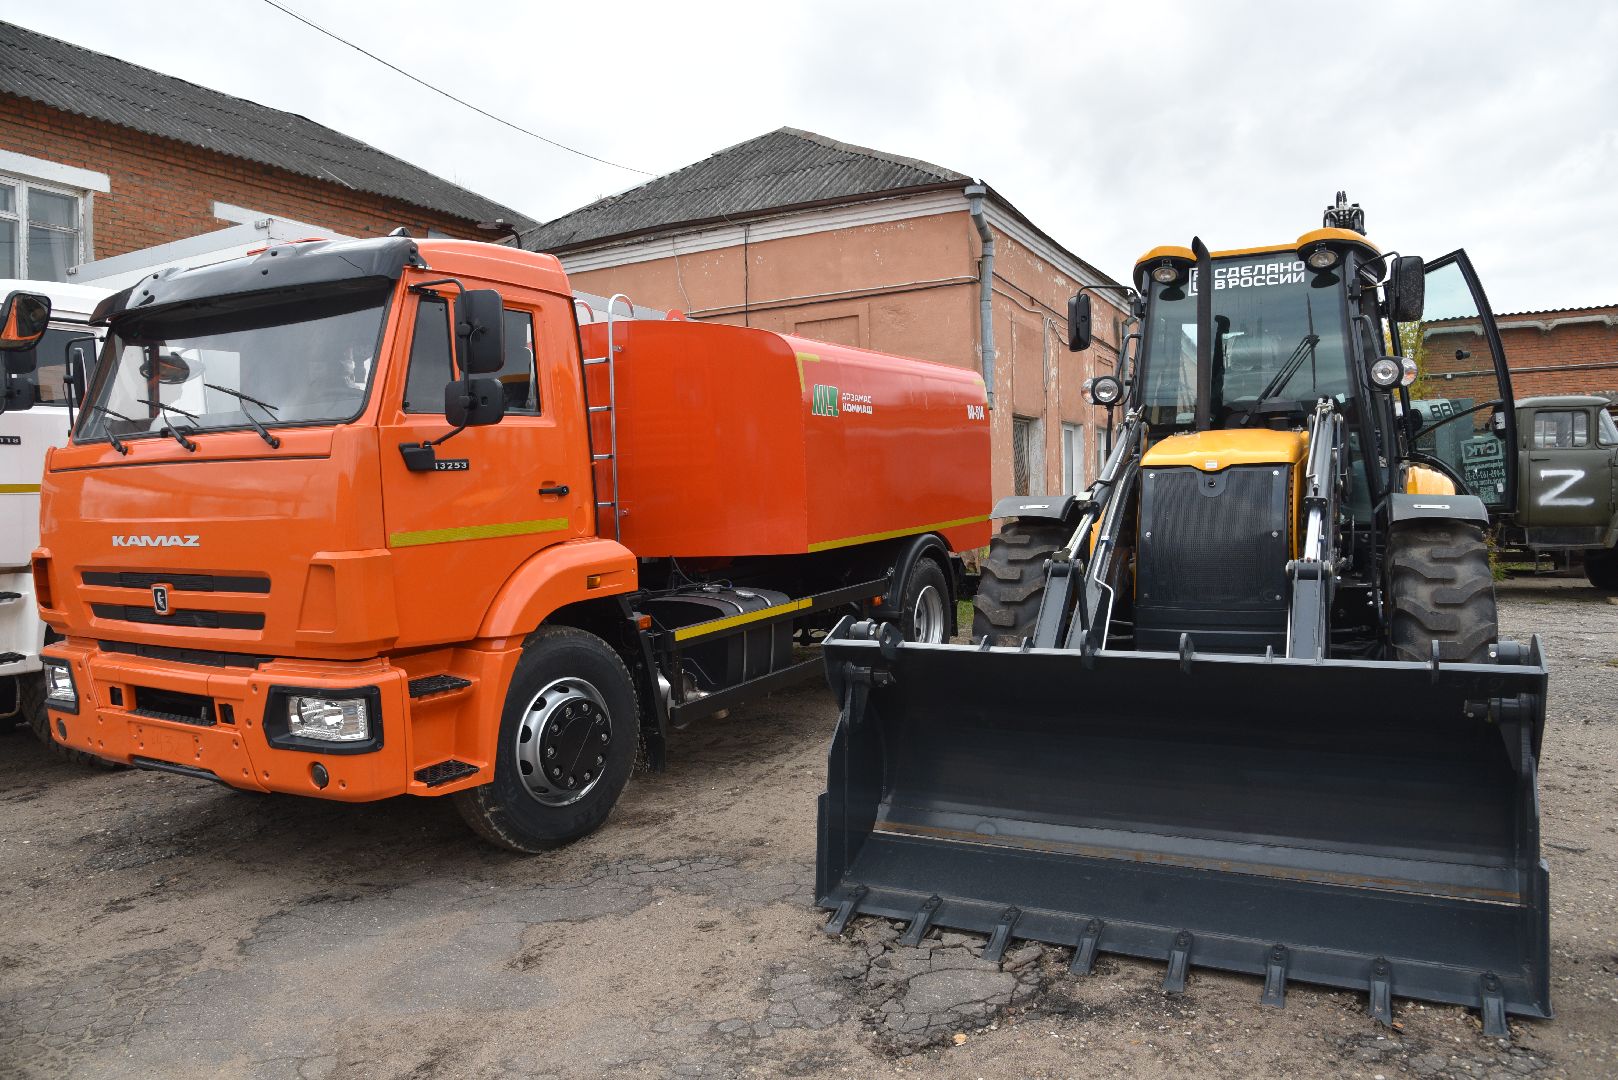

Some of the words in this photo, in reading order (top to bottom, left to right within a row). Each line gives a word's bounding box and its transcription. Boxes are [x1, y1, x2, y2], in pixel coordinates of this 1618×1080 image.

[1214, 261, 1306, 279] СДЕЛАНО
[1214, 279, 1226, 290] В
[1228, 271, 1305, 289] РОССИИ
[842, 392, 872, 404] АРЗАМАС
[842, 403, 873, 415] КОММАШ
[1539, 469, 1595, 507] Z
[112, 535, 200, 547] KAMAZ
